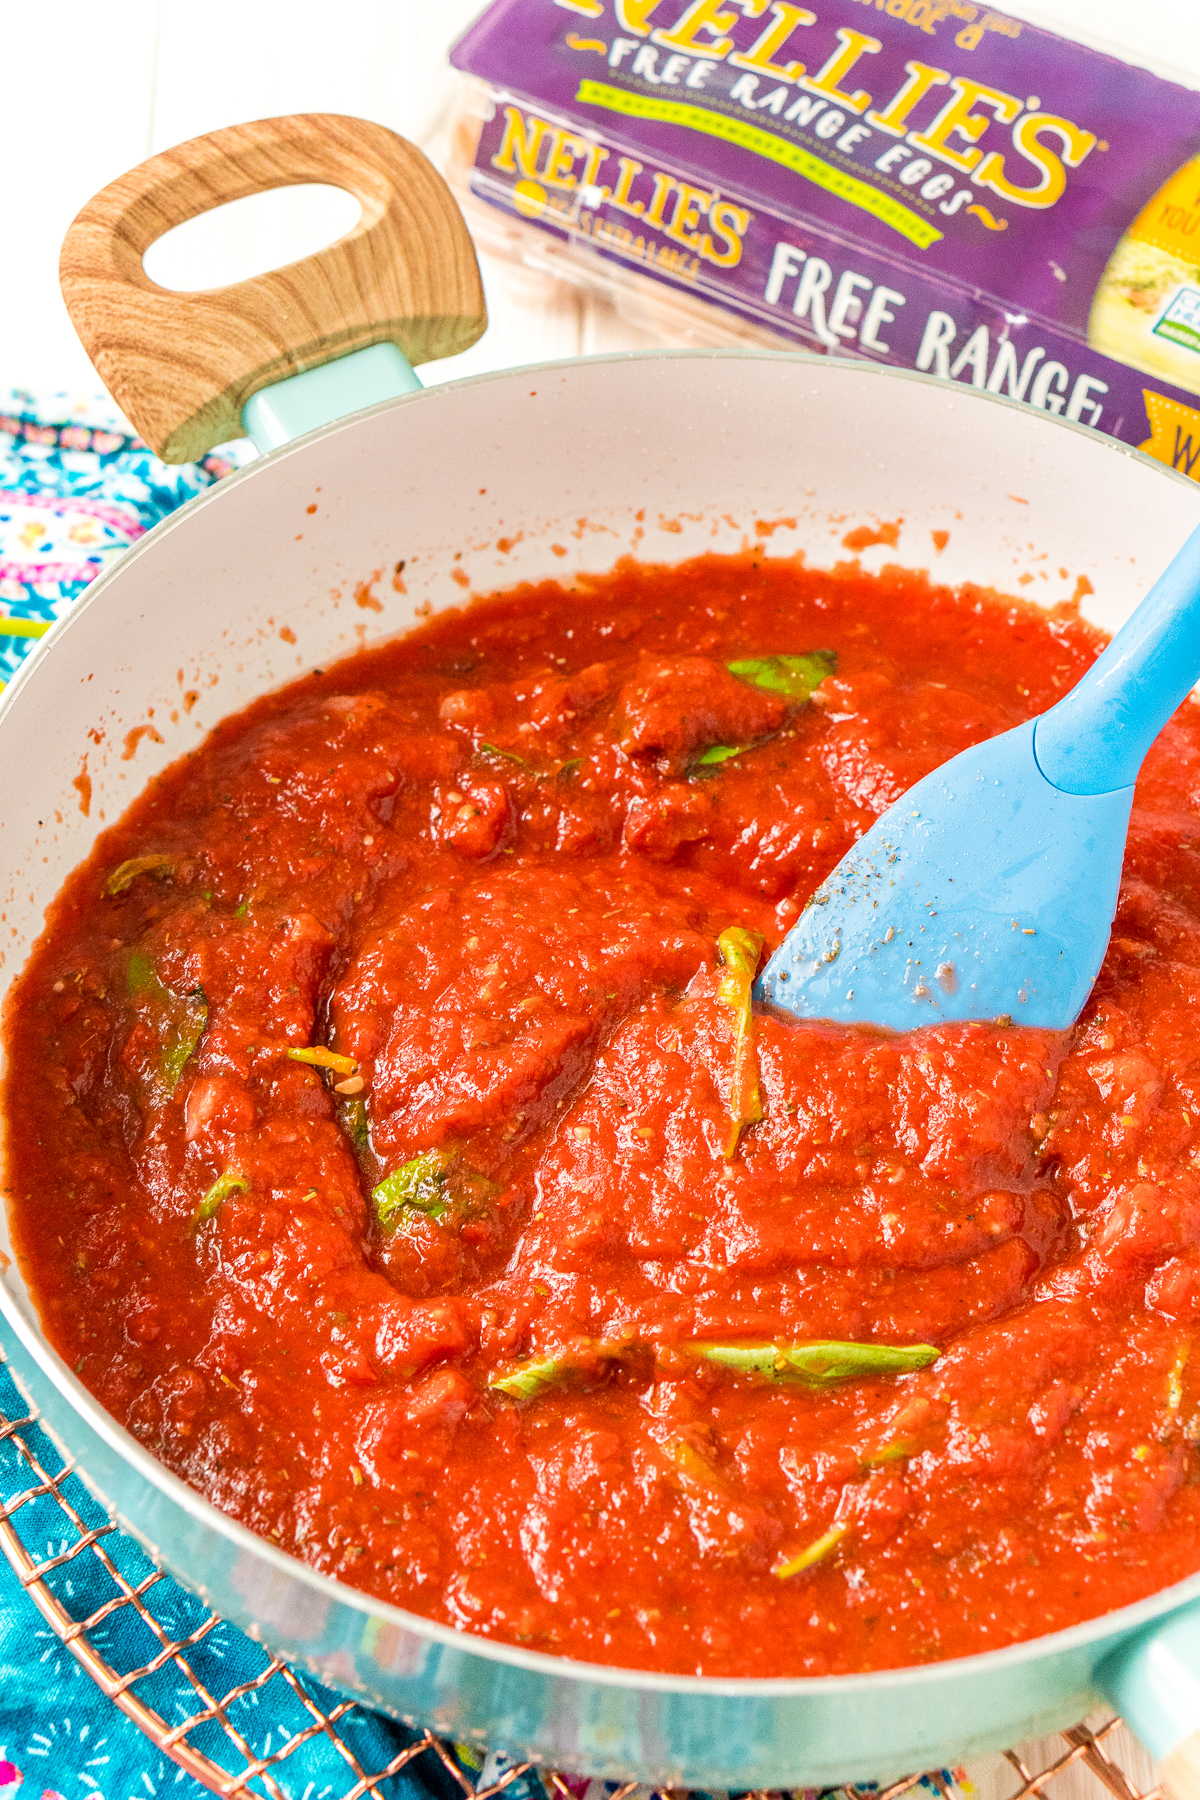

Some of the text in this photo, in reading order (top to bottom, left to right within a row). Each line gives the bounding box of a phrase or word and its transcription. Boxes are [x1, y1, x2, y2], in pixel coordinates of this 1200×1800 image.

[491, 107, 751, 268] NELLIE'S
[607, 37, 718, 88] FREE
[730, 73, 872, 154] RANGE
[874, 144, 974, 216] EGGS
[765, 242, 1109, 422] FREE RANGE
